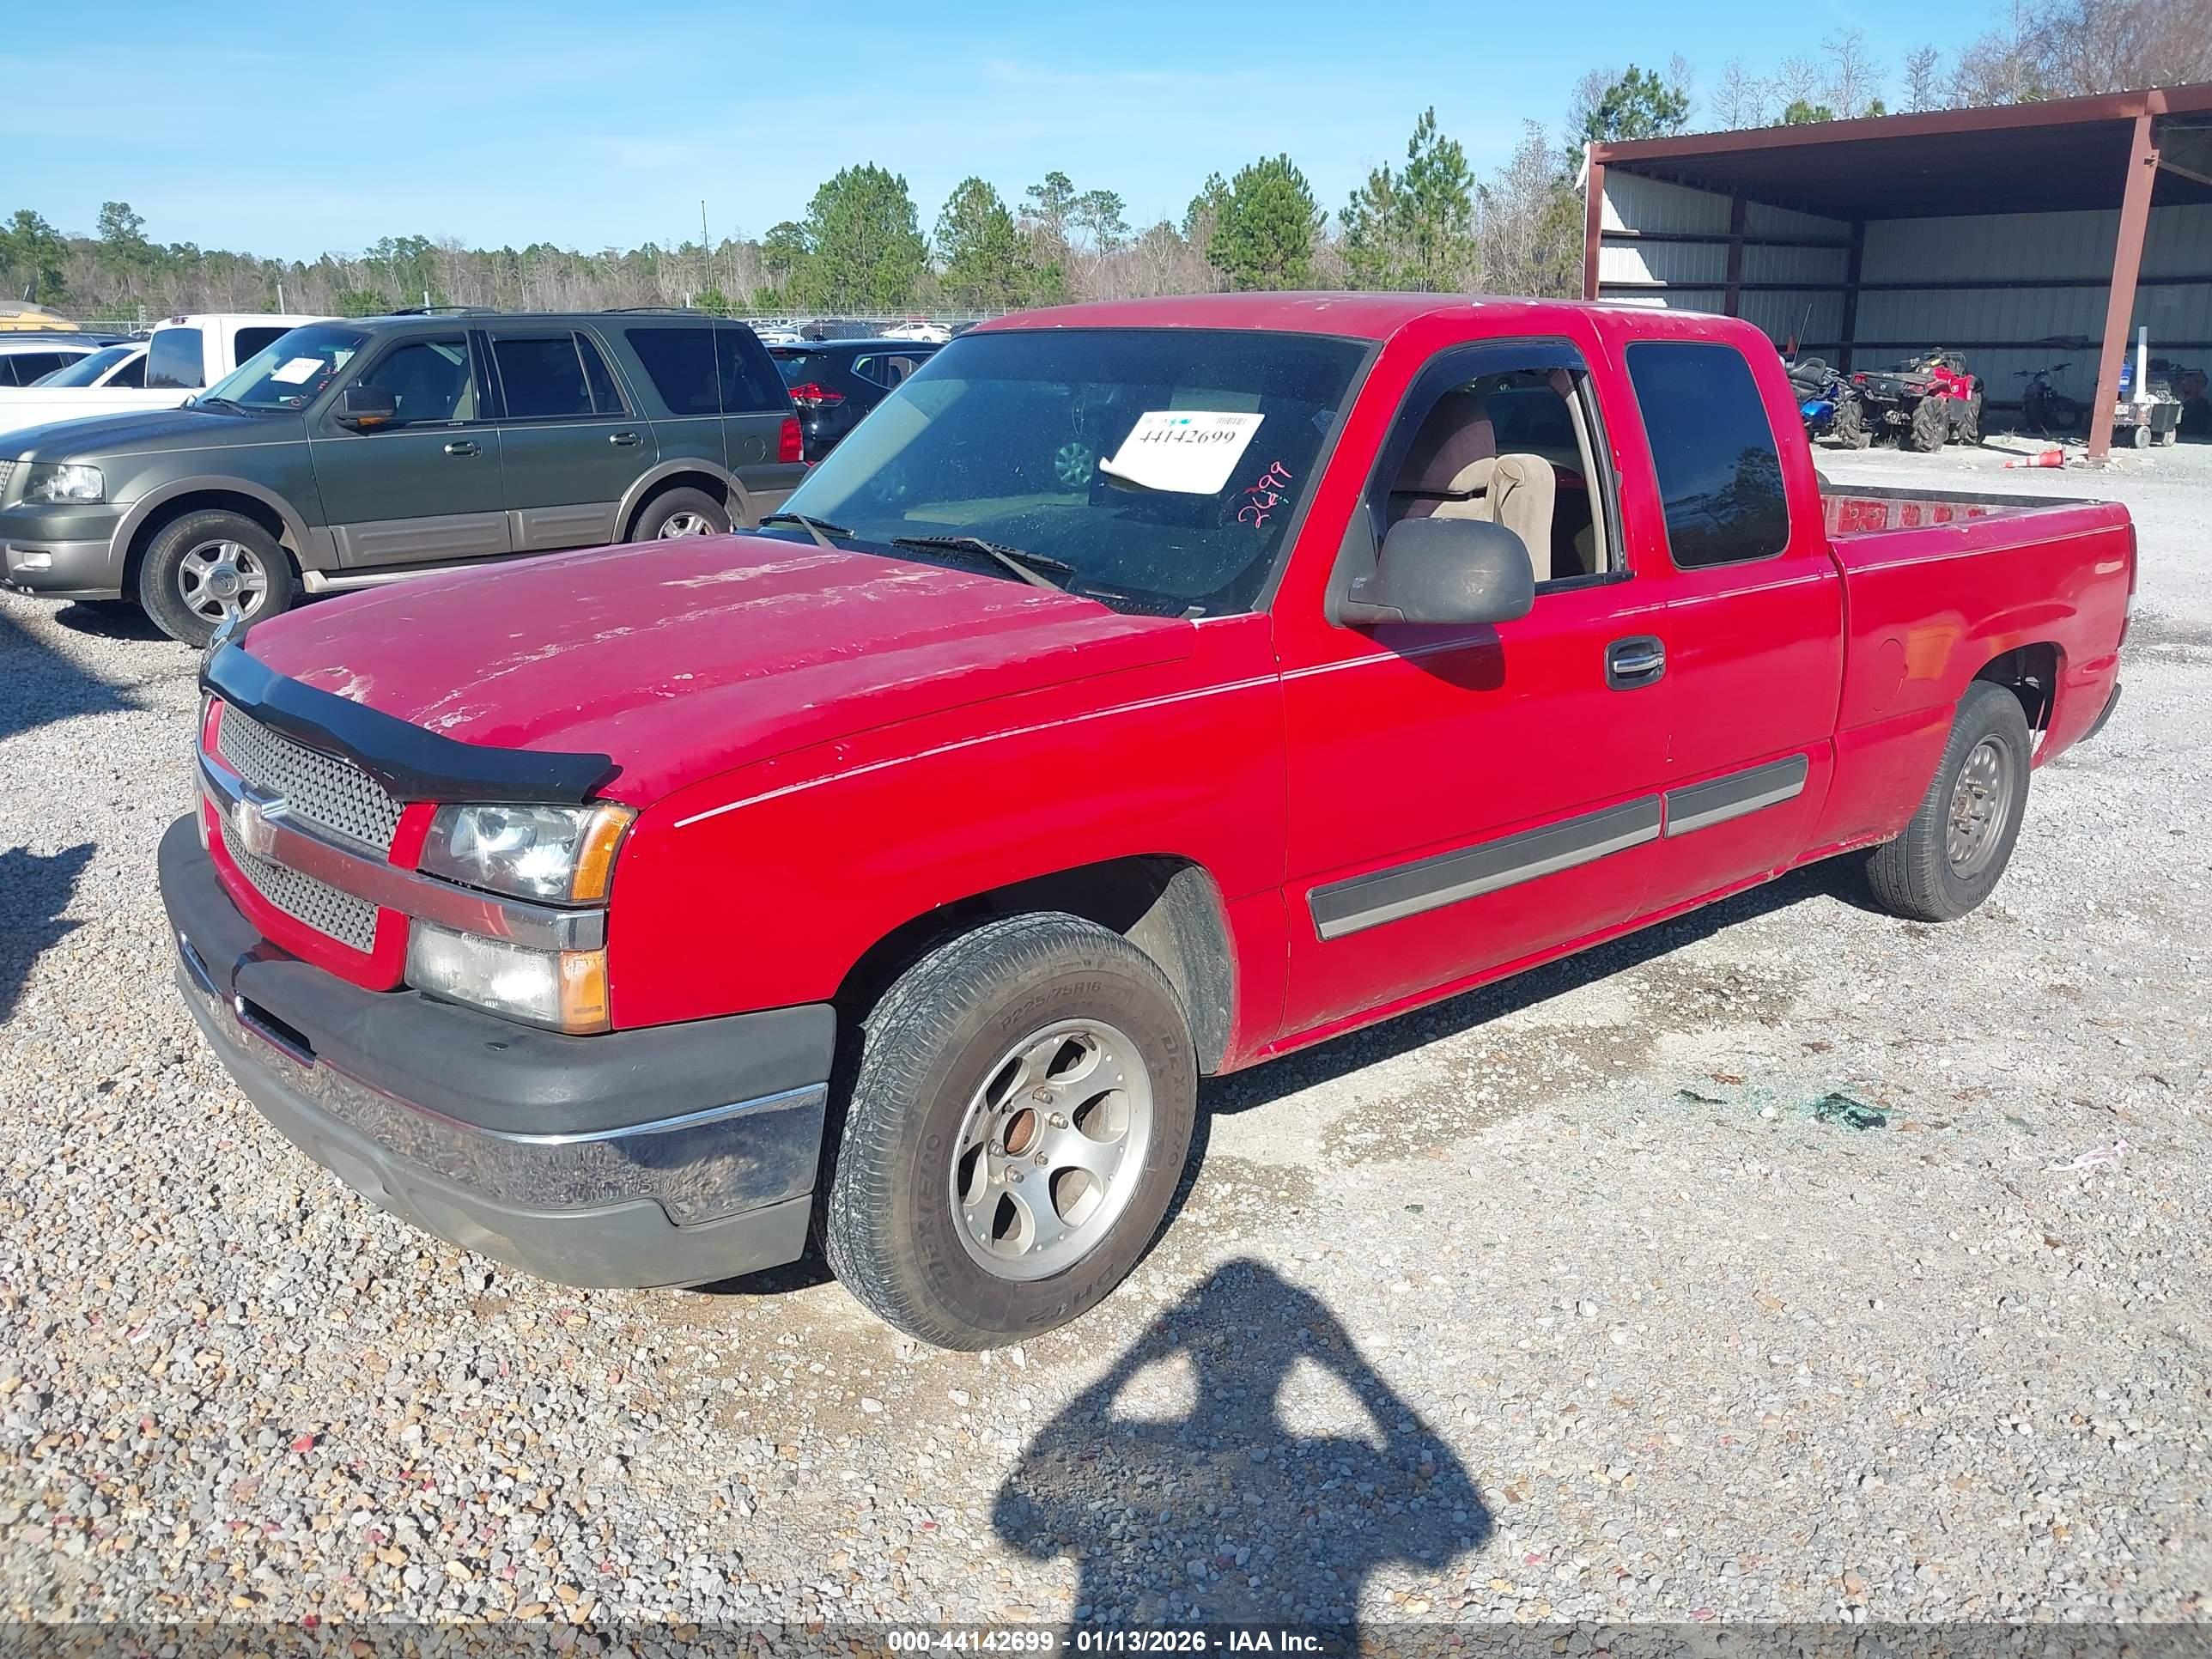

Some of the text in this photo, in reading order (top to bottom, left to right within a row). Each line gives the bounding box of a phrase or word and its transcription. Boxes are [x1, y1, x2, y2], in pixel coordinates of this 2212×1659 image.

[1139, 429, 1237, 445] 44142699
[1237, 461, 1293, 529] 2699
[1000, 981, 1103, 1030] P225/75R16
